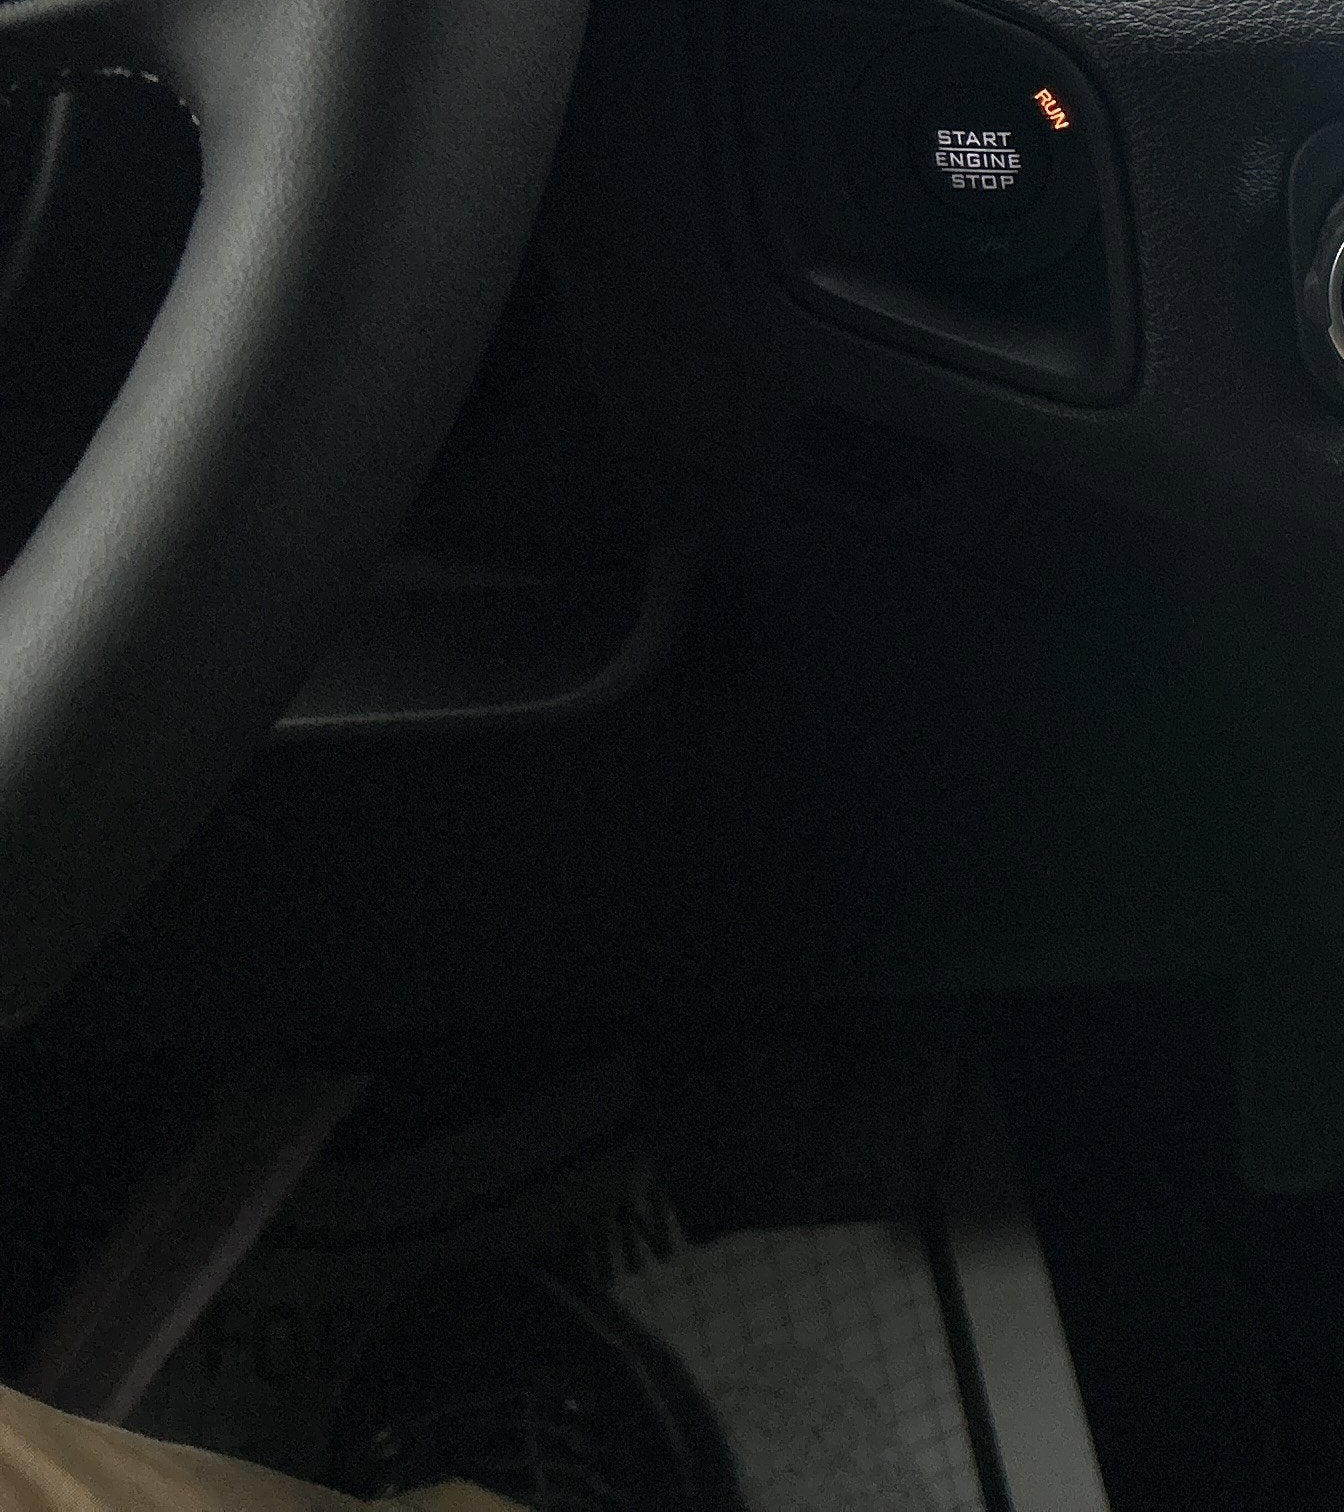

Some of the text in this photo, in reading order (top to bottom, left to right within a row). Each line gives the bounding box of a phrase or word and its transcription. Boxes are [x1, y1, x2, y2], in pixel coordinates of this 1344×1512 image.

[1033, 88, 1070, 130] RUN
[937, 129, 1012, 146] START
[935, 150, 1021, 170] ENGINE
[951, 173, 1015, 190] STOP
